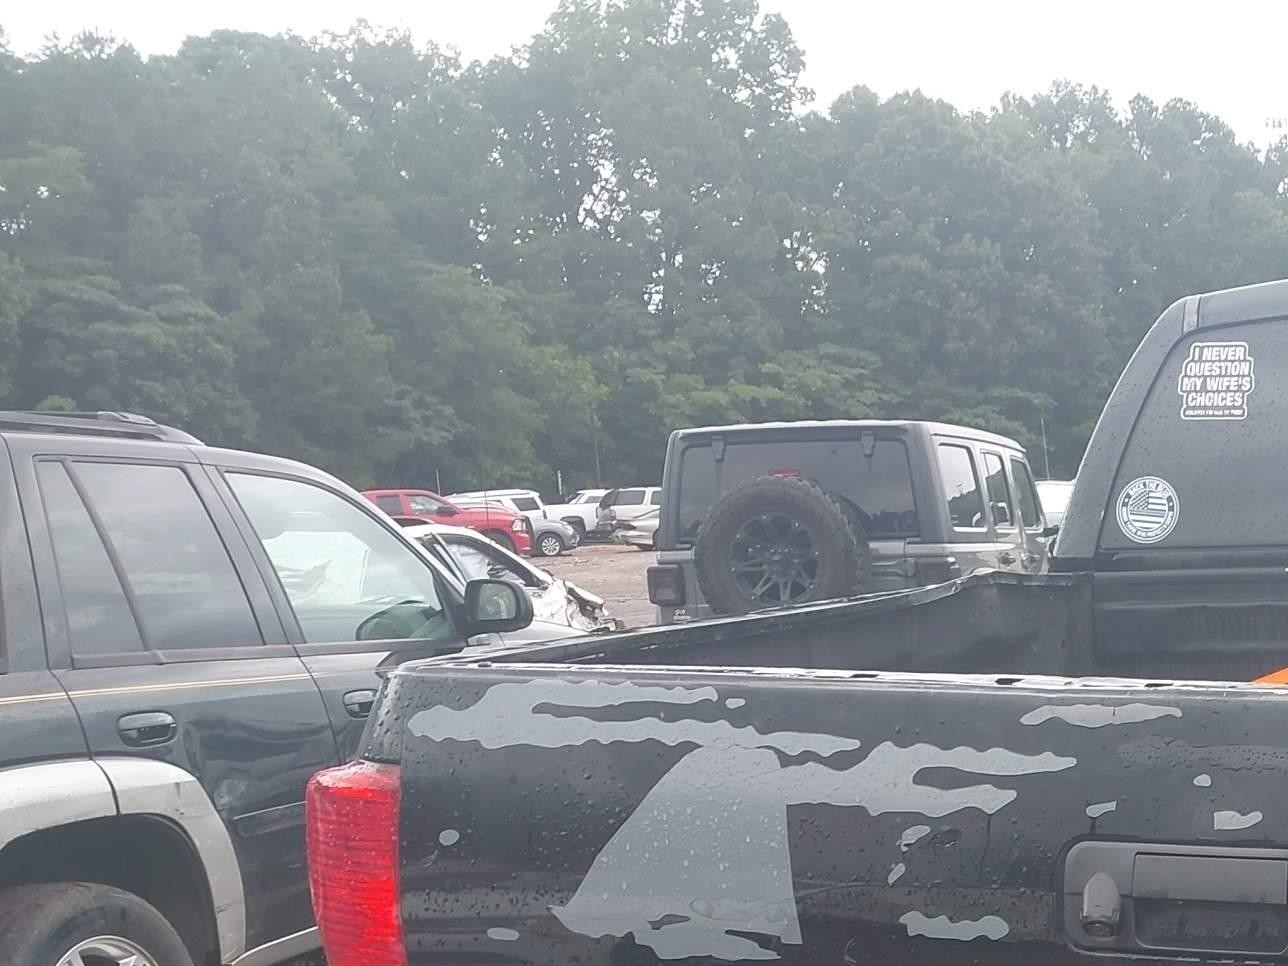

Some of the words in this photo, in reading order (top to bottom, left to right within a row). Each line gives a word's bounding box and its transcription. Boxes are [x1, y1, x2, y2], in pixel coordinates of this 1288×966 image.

[1195, 347, 1200, 360] I
[1202, 346, 1244, 361] NEVER
[1186, 361, 1250, 376] QUESTION
[1182, 377, 1203, 391] MY
[1206, 377, 1252, 391] WIFE'S
[1187, 392, 1242, 406] CHOICES
